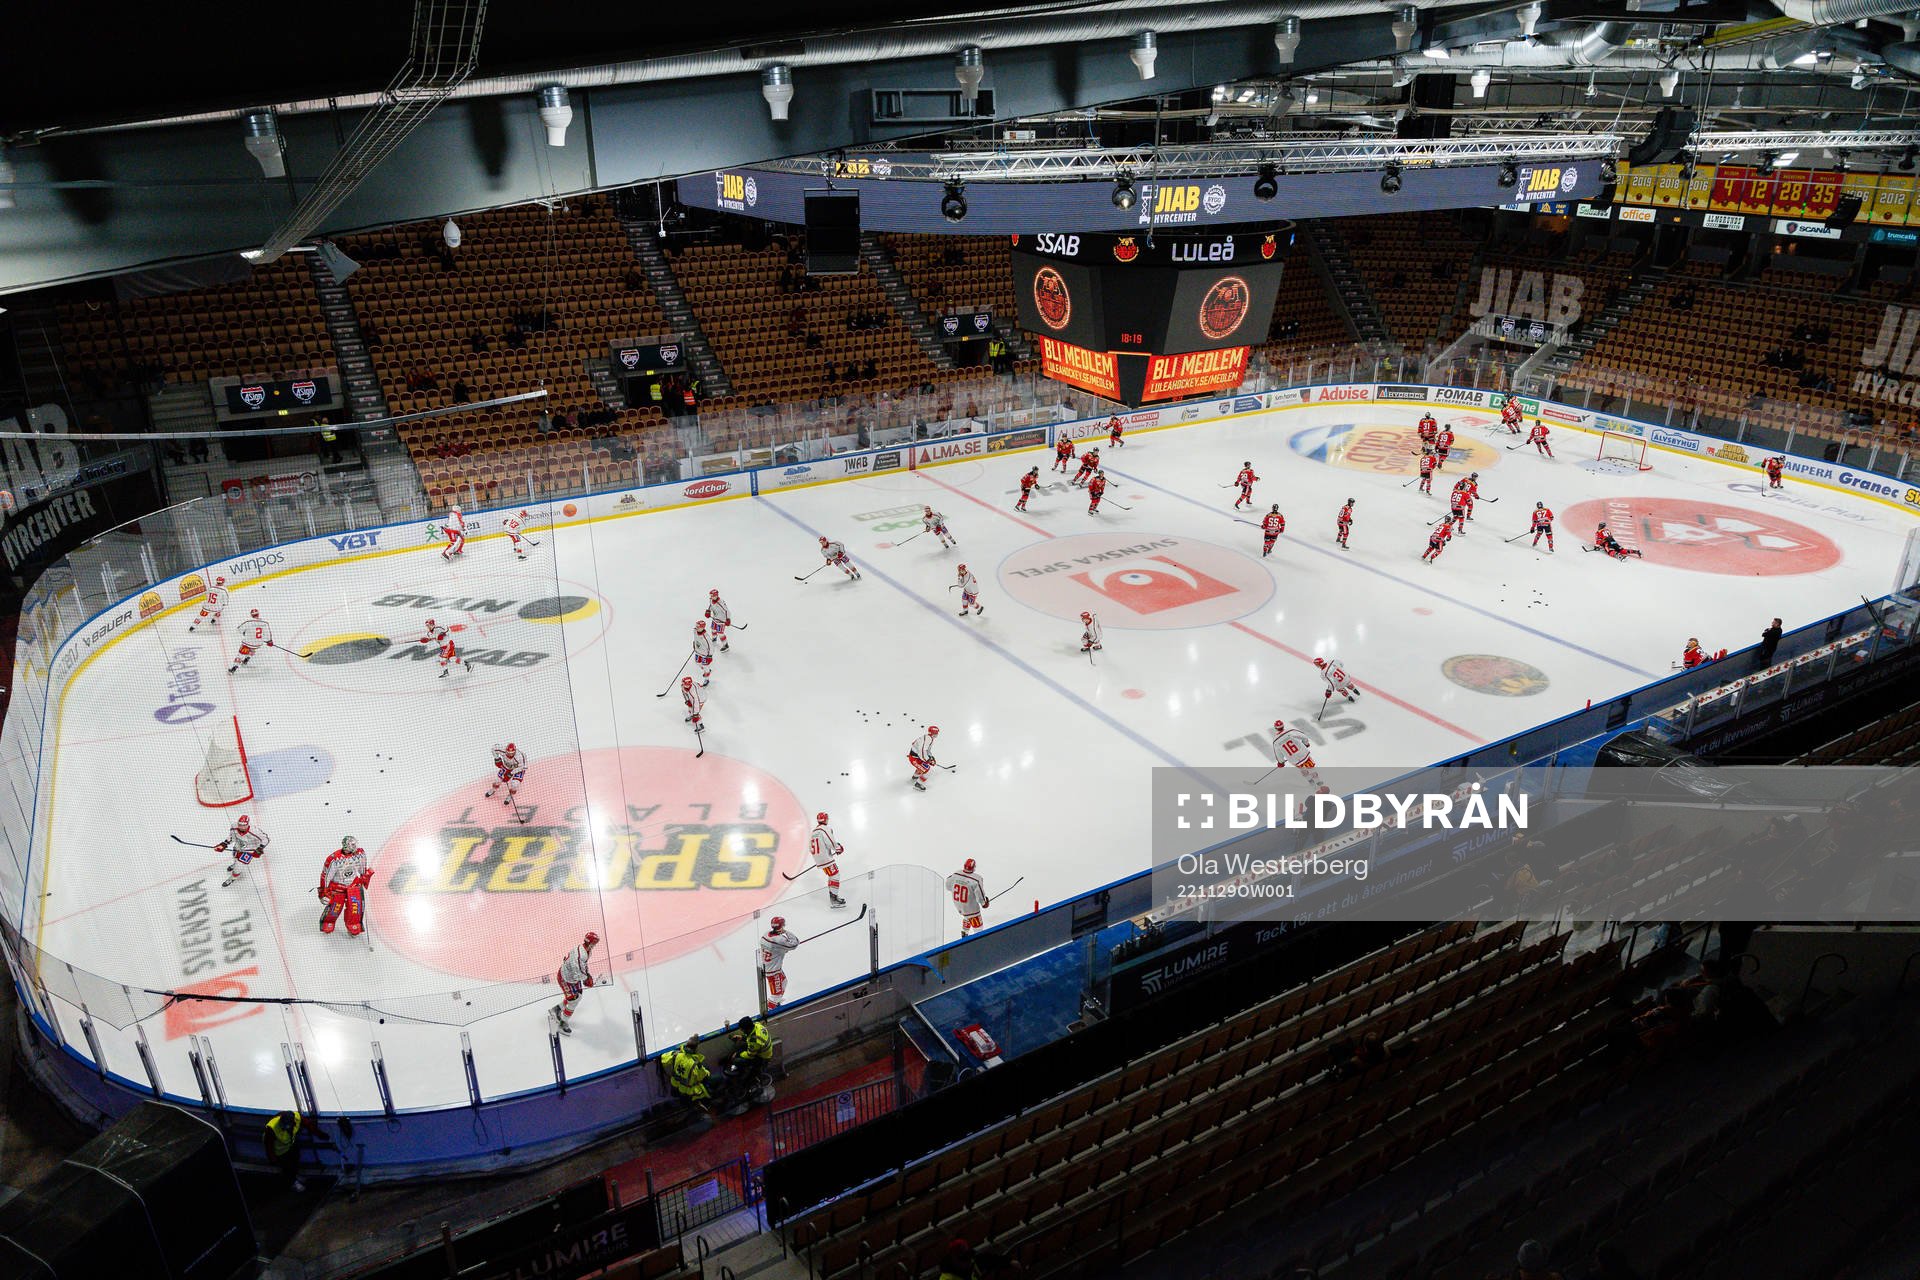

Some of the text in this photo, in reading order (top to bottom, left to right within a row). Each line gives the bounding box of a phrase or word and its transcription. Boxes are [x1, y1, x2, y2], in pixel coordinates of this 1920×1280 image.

[723, 174, 744, 200] JIAB
[1528, 168, 1560, 191] JIAB
[1632, 176, 1653, 187] 2019
[1660, 178, 1680, 189] 2018
[1724, 178, 1734, 196] 4
[1750, 180, 1768, 199] 12
[1154, 185, 1200, 213] JIAB
[1779, 181, 1803, 201] 28
[1811, 183, 1837, 204] 35
[1879, 192, 1906, 205] 2012
[1153, 212, 1197, 224] HYRCENTER
[1621, 210, 1651, 221] office
[1798, 225, 1832, 235] SCANIA
[1036, 233, 1081, 256] SSAB
[1469, 266, 1585, 326] JIAB
[1120, 332, 1143, 344] 18:19
[1044, 338, 1114, 378] BLI MEDLEM
[1153, 348, 1243, 381] BLI MEDLEM
[1318, 386, 1369, 401] Advise
[1435, 388, 1483, 403] FOMAB
[1492, 395, 1537, 413] Dme
[1533, 428, 1542, 436] 21
[844, 456, 868, 473] JWAB
[1783, 460, 1833, 480] ANPERÄ
[1838, 471, 1900, 499] Granec
[1, 489, 97, 572] HYRCENTER
[328, 531, 382, 551] YBT
[229, 551, 285, 576] winpos
[1008, 537, 1179, 579] SVENSKA SPEL
[1282, 738, 1300, 757] 16
[388, 822, 781, 895] SPORT
[953, 883, 969, 904] 20
[177, 879, 216, 977] SVENSKA
[1255, 920, 1288, 945] Tack
[1317, 901, 1337, 918] att
[1341, 893, 1358, 908] du
[220, 909, 256, 966] SPEL
[1164, 941, 1229, 979] LUMIRE
